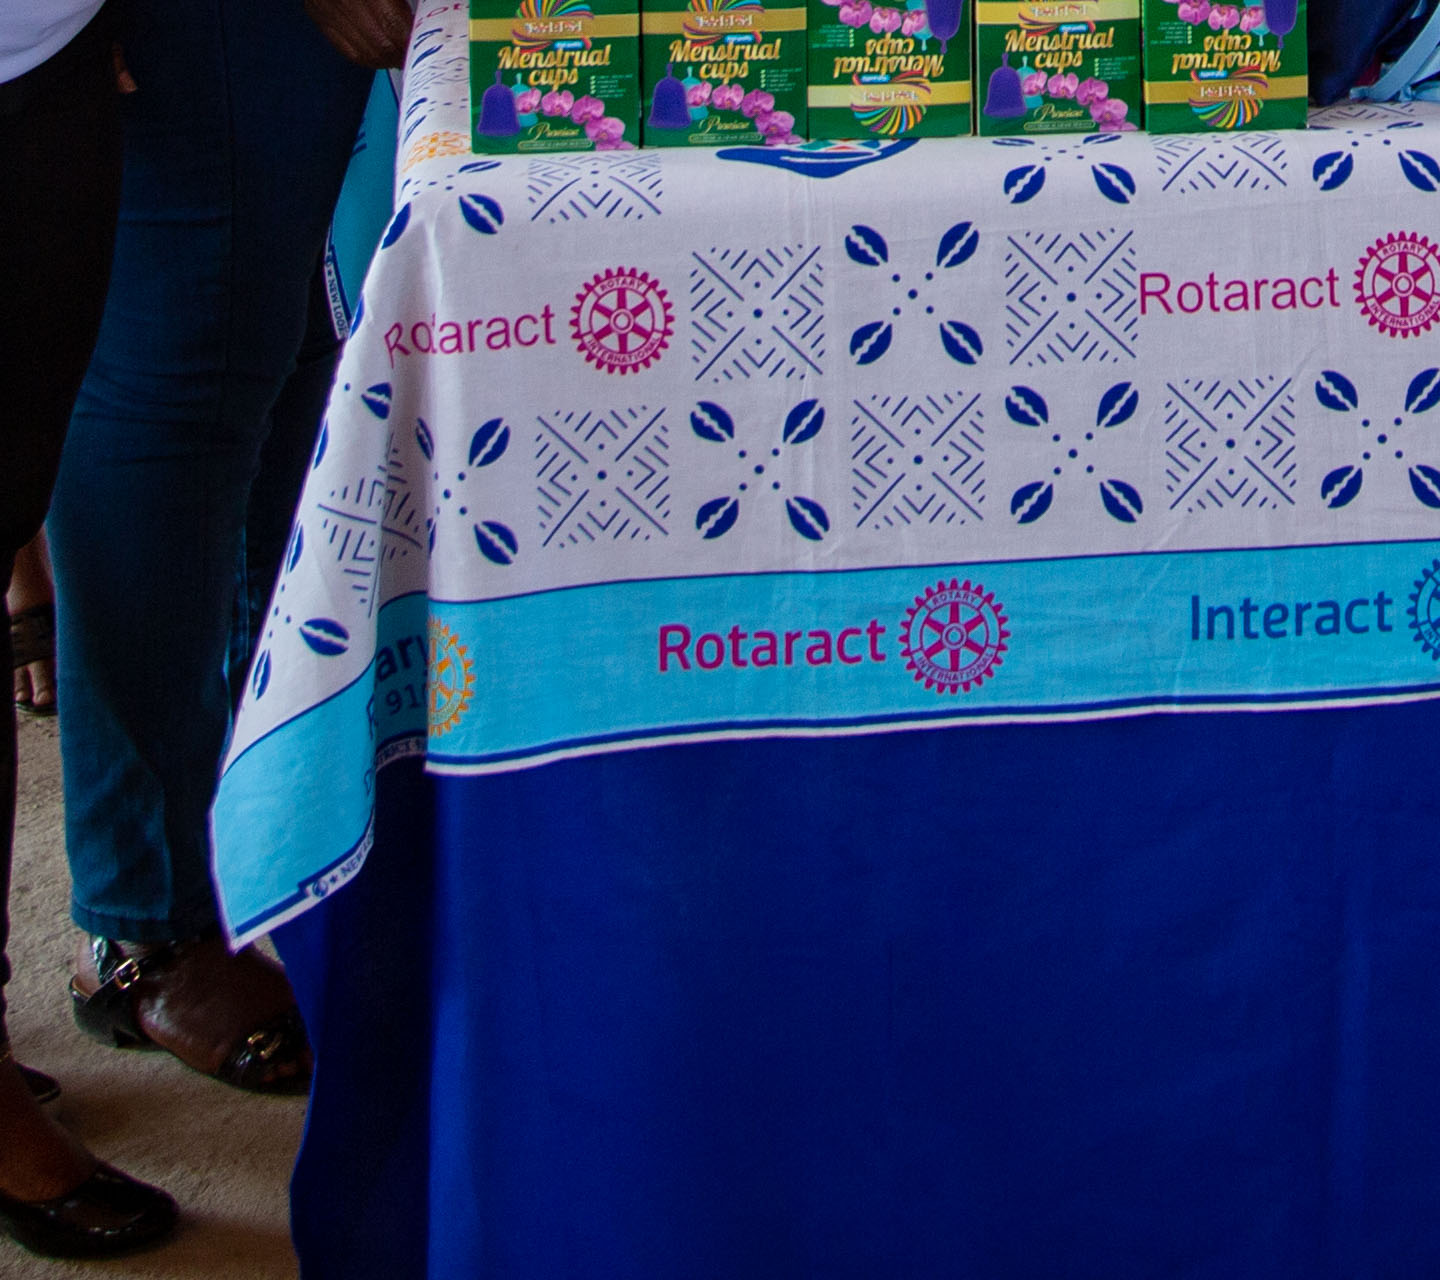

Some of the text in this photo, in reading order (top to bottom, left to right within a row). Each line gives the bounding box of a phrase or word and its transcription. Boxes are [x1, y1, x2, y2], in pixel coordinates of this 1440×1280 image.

[864, 33, 915, 57] cups
[1203, 28, 1252, 52] cups
[498, 44, 611, 70] Menstrual
[528, 67, 579, 92] cups
[1382, 241, 1423, 257] ROTARY
[600, 277, 642, 292] ROTARY
[1140, 267, 1340, 315] Rotaract
[1369, 298, 1440, 328] INTERNATIONAL
[587, 336, 660, 365] INTERNATIONAL
[932, 591, 978, 606] ROTARY
[1191, 591, 1393, 640] Interact
[659, 619, 887, 672] Rotaract
